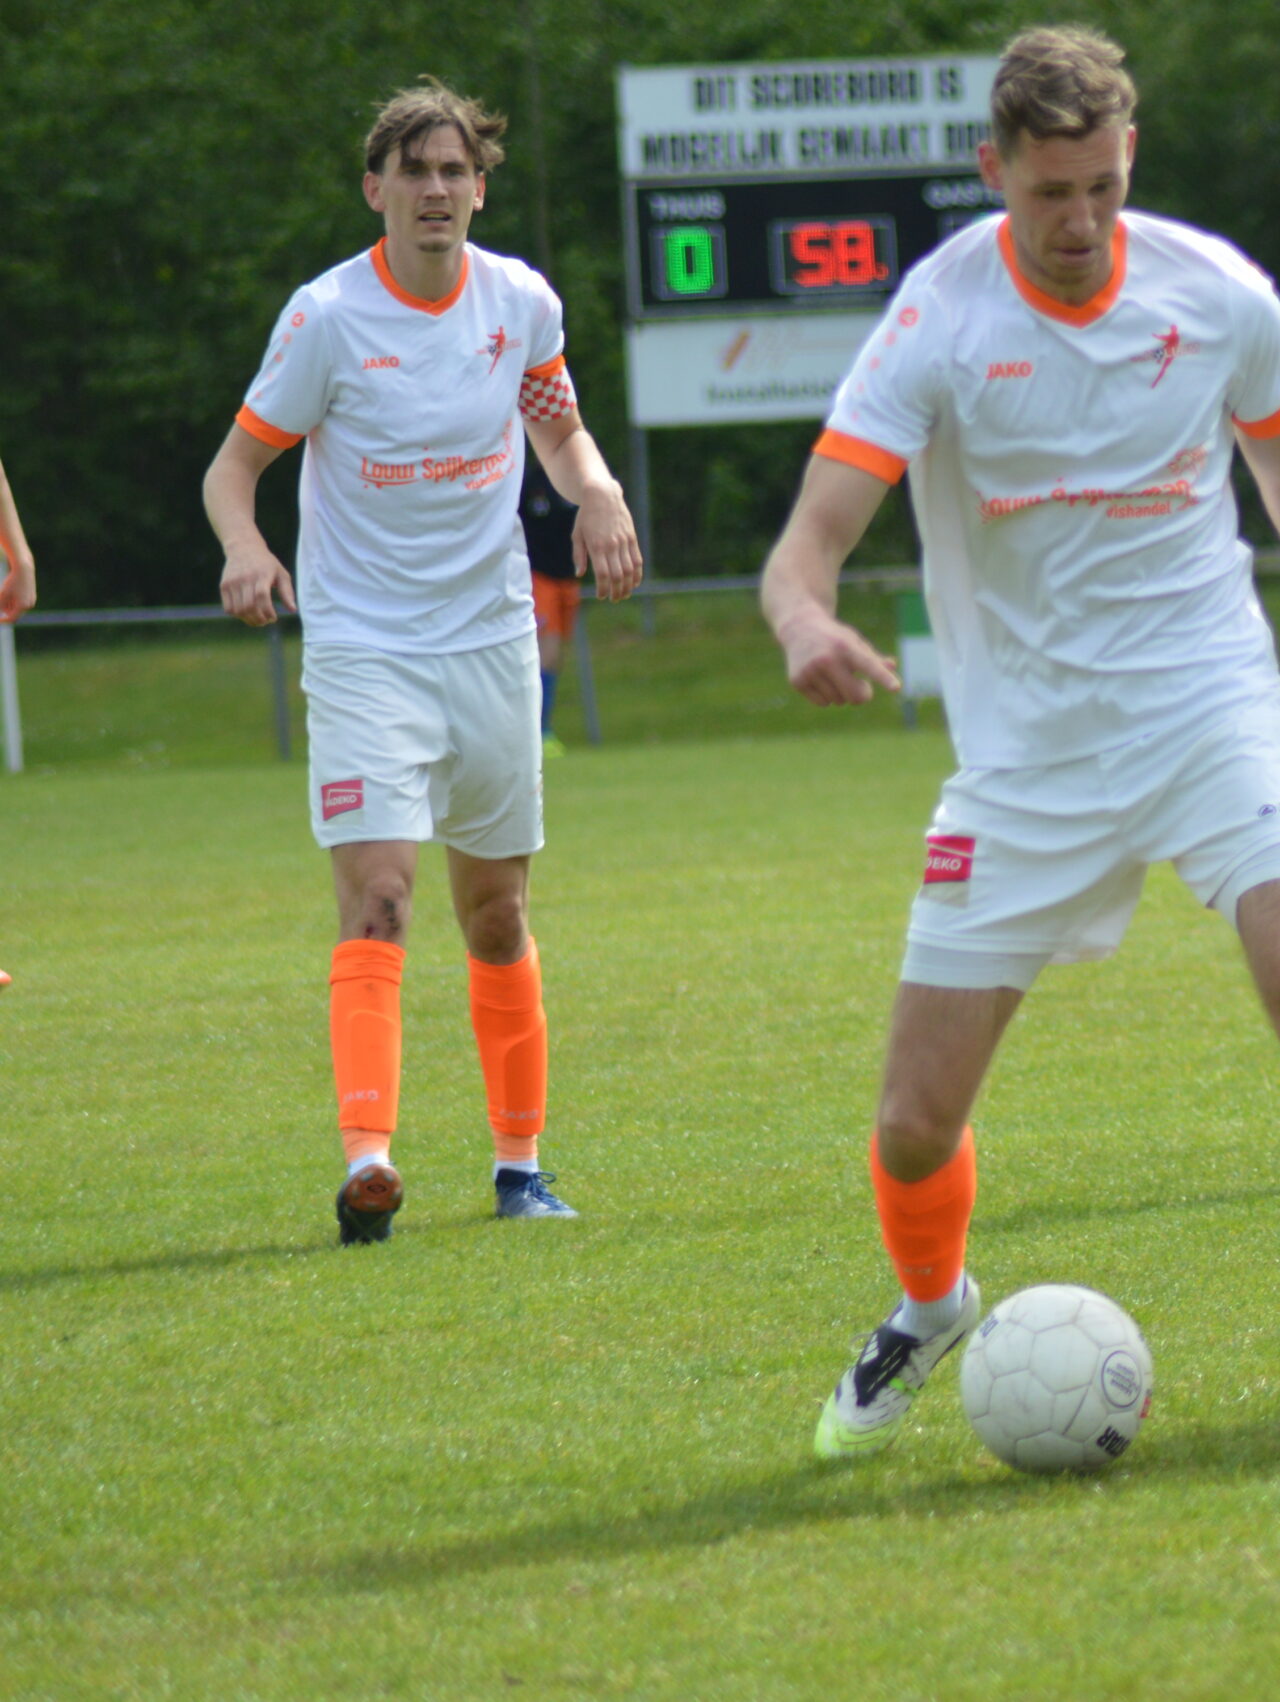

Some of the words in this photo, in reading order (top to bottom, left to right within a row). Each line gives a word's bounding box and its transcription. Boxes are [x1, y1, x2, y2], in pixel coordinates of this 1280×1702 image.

[693, 76, 736, 113] DIT
[752, 69, 922, 110] SCOREBORD
[936, 66, 964, 101] IS
[666, 227, 714, 293] 0
[362, 356, 400, 370] JAKO
[986, 362, 1033, 380] JAKO
[1105, 502, 1172, 519] vishandel
